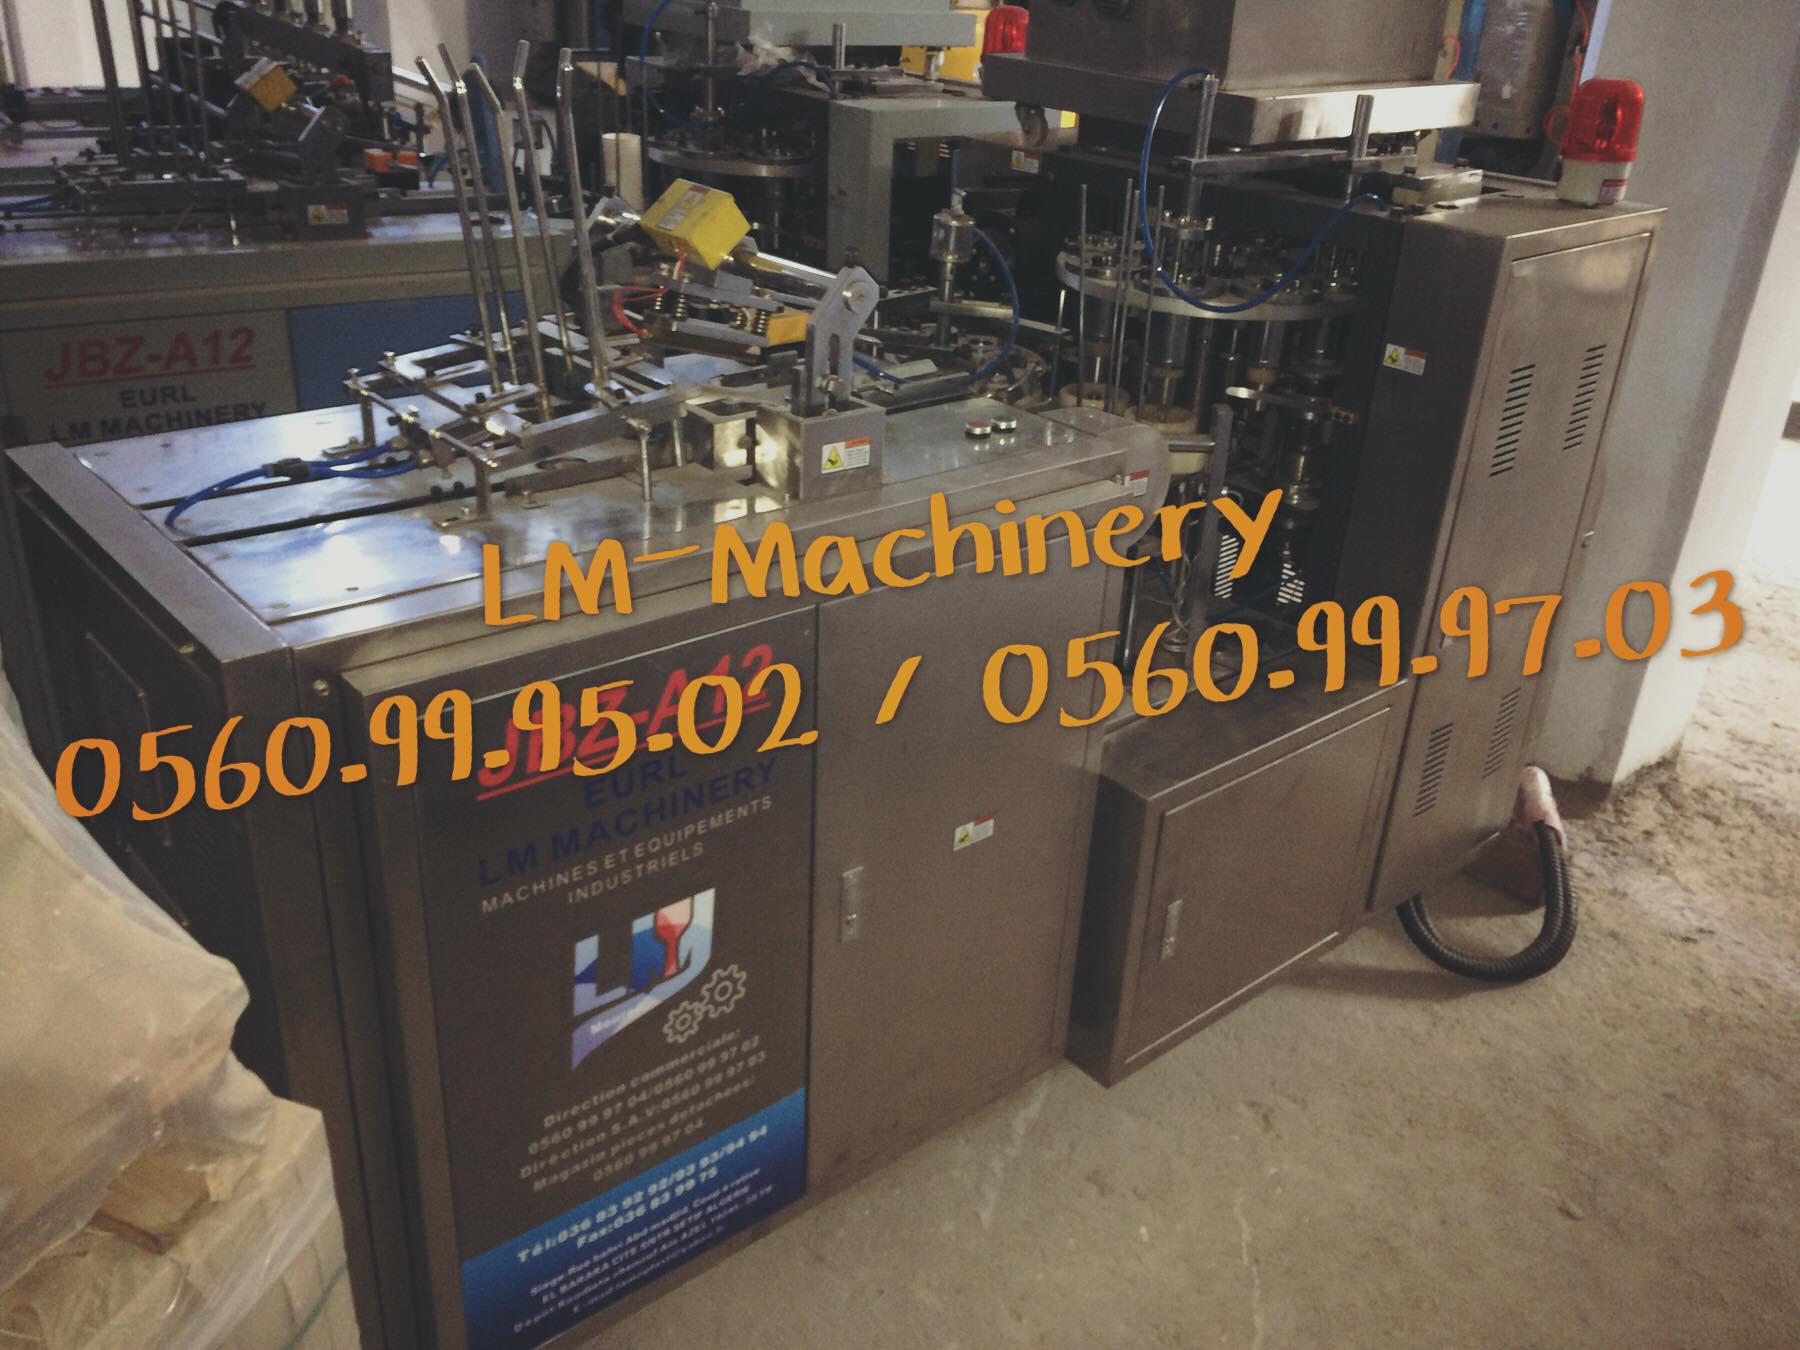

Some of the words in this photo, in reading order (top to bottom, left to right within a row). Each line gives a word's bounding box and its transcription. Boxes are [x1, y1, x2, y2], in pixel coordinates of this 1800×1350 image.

[45, 325, 258, 384] JBZ-A12
[101, 402, 267, 437] MACHINERY
[118, 385, 196, 409] EURL
[583, 755, 690, 812] EURL
[479, 843, 540, 888] LM
[550, 757, 778, 858] MACHINERY
[480, 860, 600, 914] MACHINES
[603, 848, 631, 872] ET
[634, 795, 774, 859] EQUIPEMENTS
[568, 842, 705, 904] INDUSTRIELS
